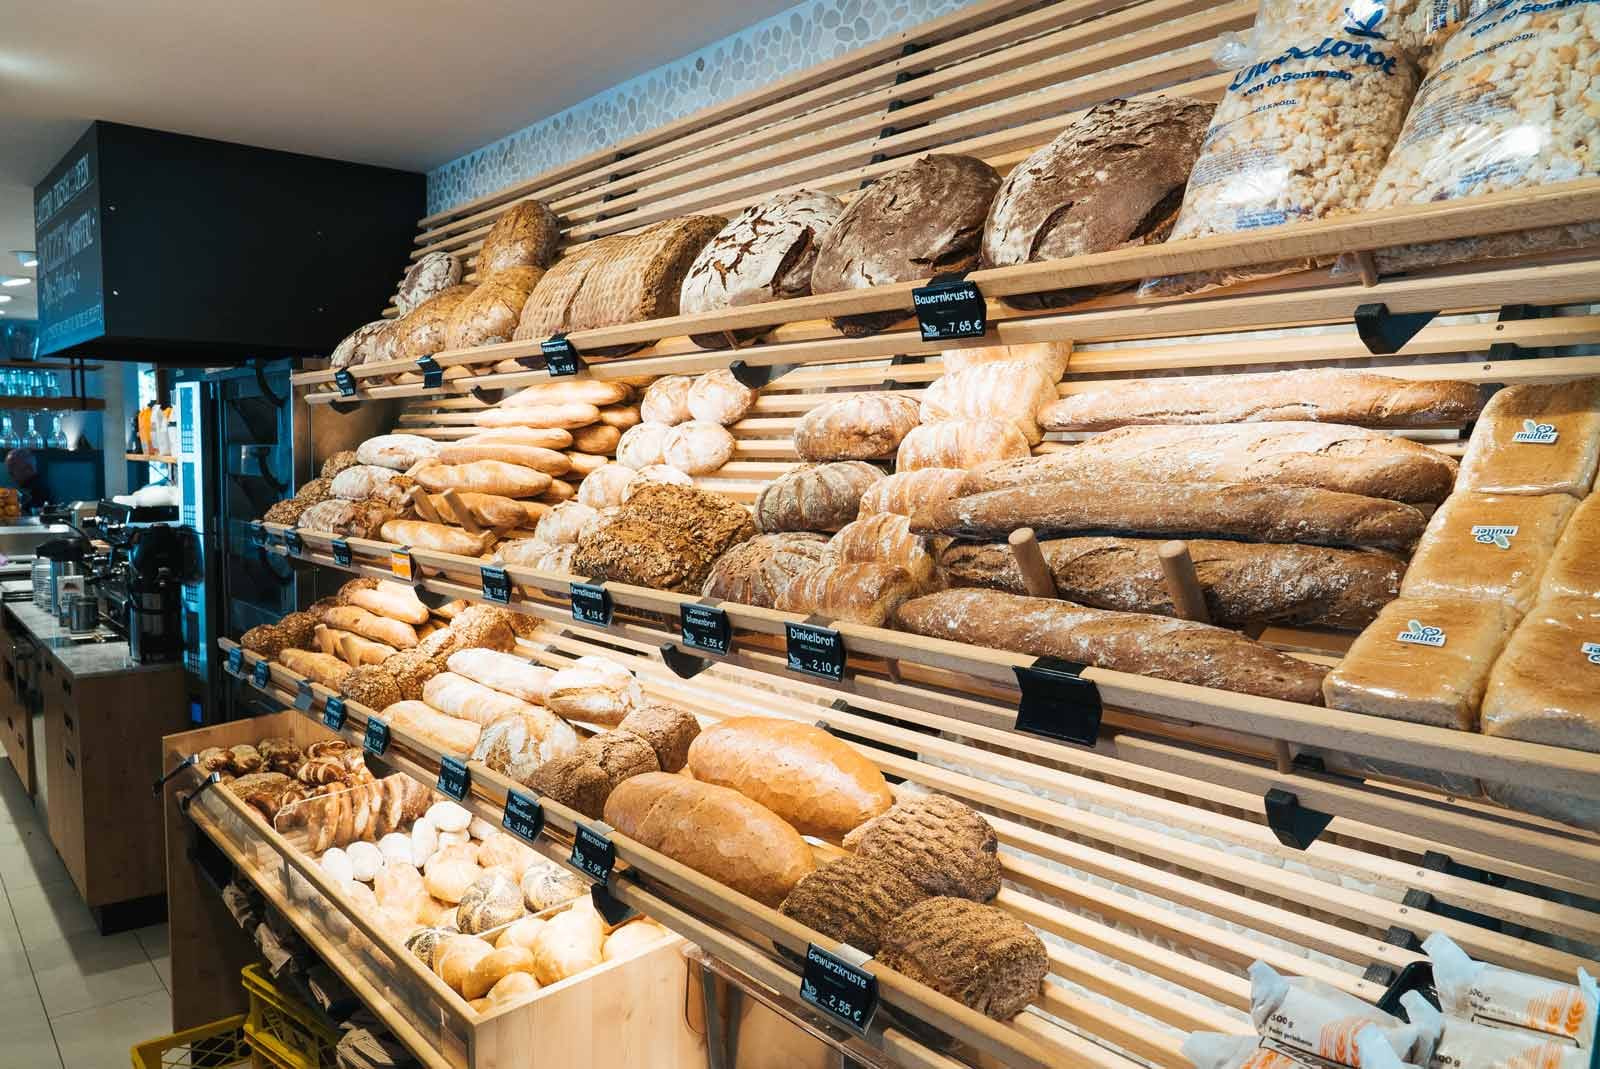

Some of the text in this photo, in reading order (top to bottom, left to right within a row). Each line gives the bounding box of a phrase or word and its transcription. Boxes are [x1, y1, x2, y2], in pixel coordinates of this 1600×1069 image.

[1266, 75, 1281, 87] 10
[914, 289, 976, 305] Bauernkruste
[948, 320, 971, 334] 7,65
[974, 319, 982, 330] €
[1516, 430, 1553, 440] müller
[790, 627, 835, 647] Dinkelbrot
[1401, 632, 1442, 643] müller
[812, 659, 831, 673] 2,10
[833, 664, 840, 675] €
[829, 994, 851, 1016] 2,55
[853, 1009, 862, 1022] €
[1270, 1014, 1288, 1025] 500
